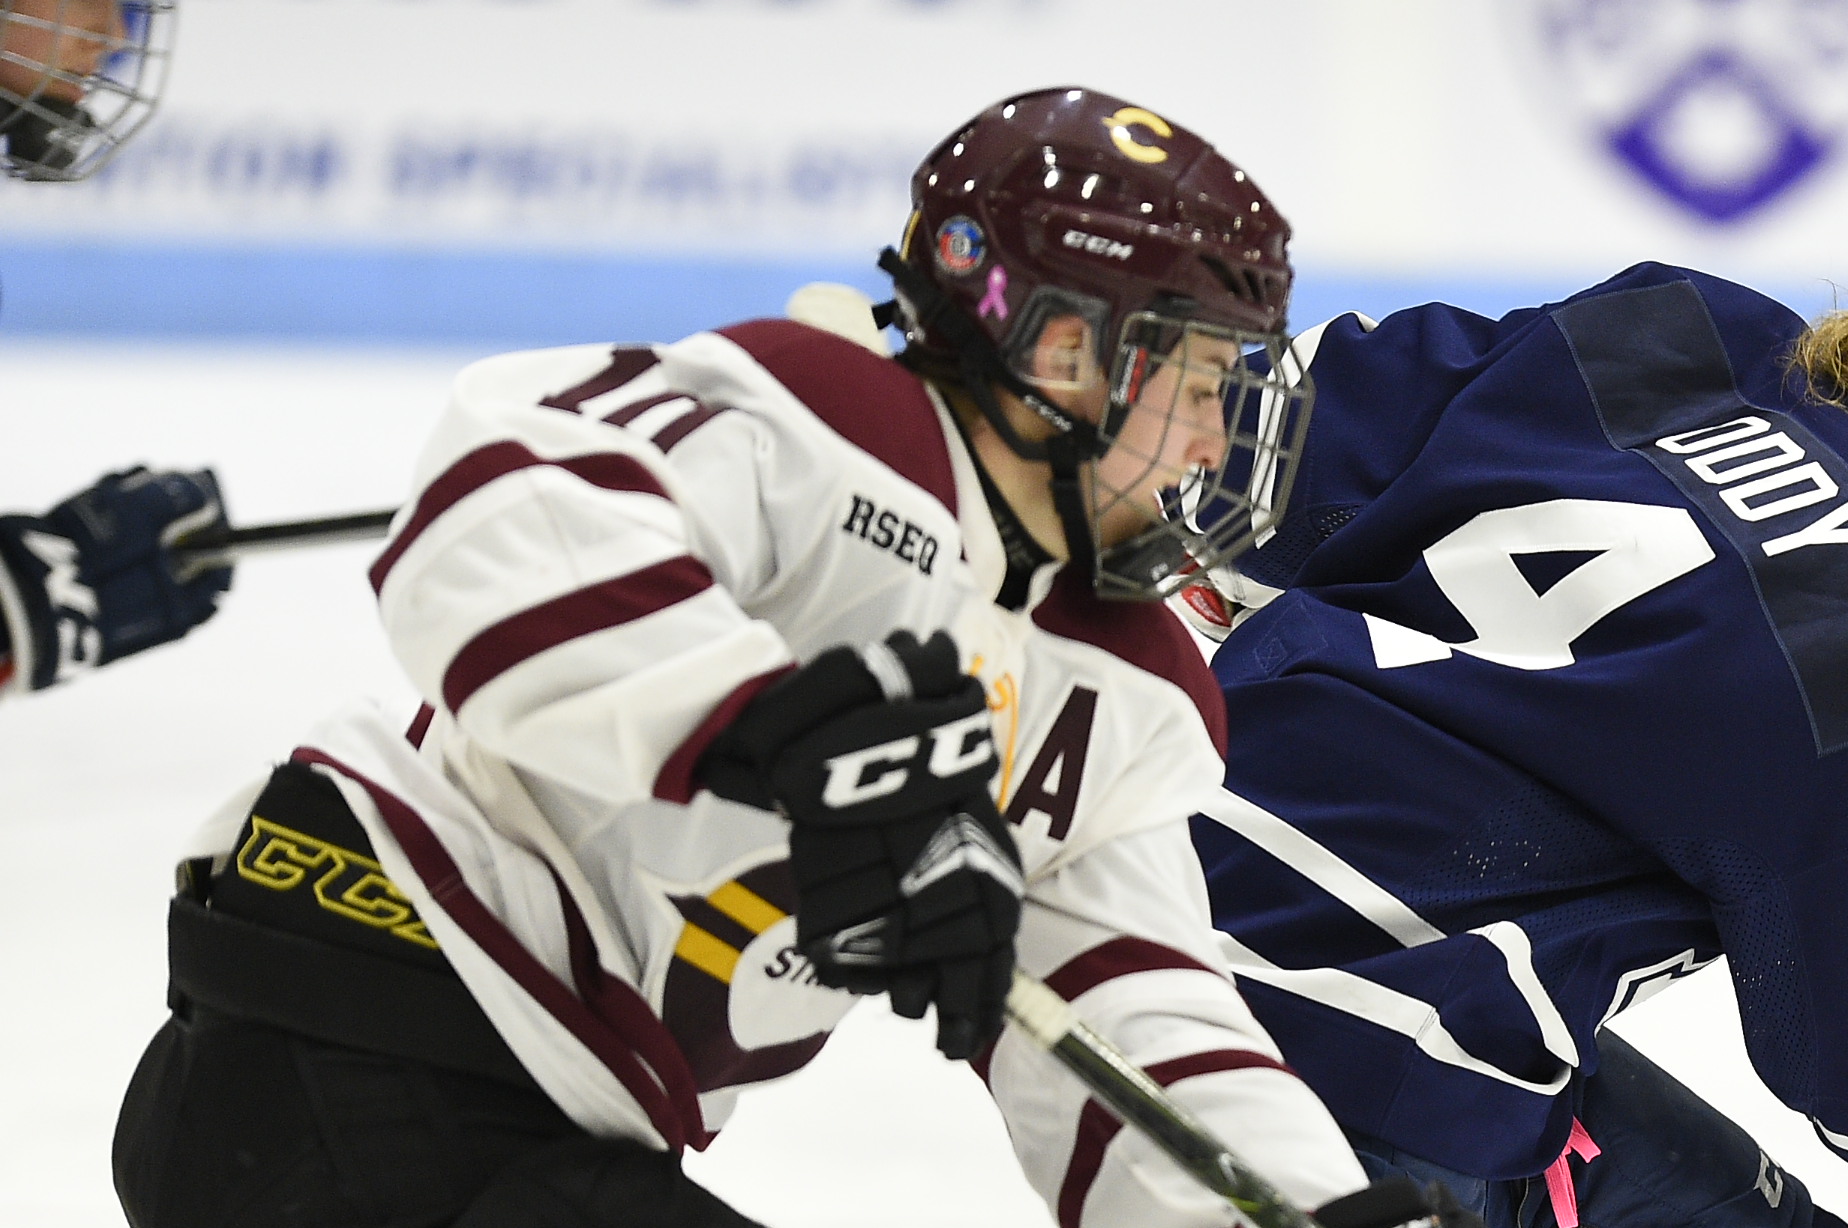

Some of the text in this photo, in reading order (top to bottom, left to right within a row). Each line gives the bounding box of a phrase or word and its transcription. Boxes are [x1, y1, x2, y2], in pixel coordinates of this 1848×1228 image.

[1062, 229, 1134, 260] CCM
[843, 494, 938, 577] RSEQ
[1005, 685, 1098, 842] A
